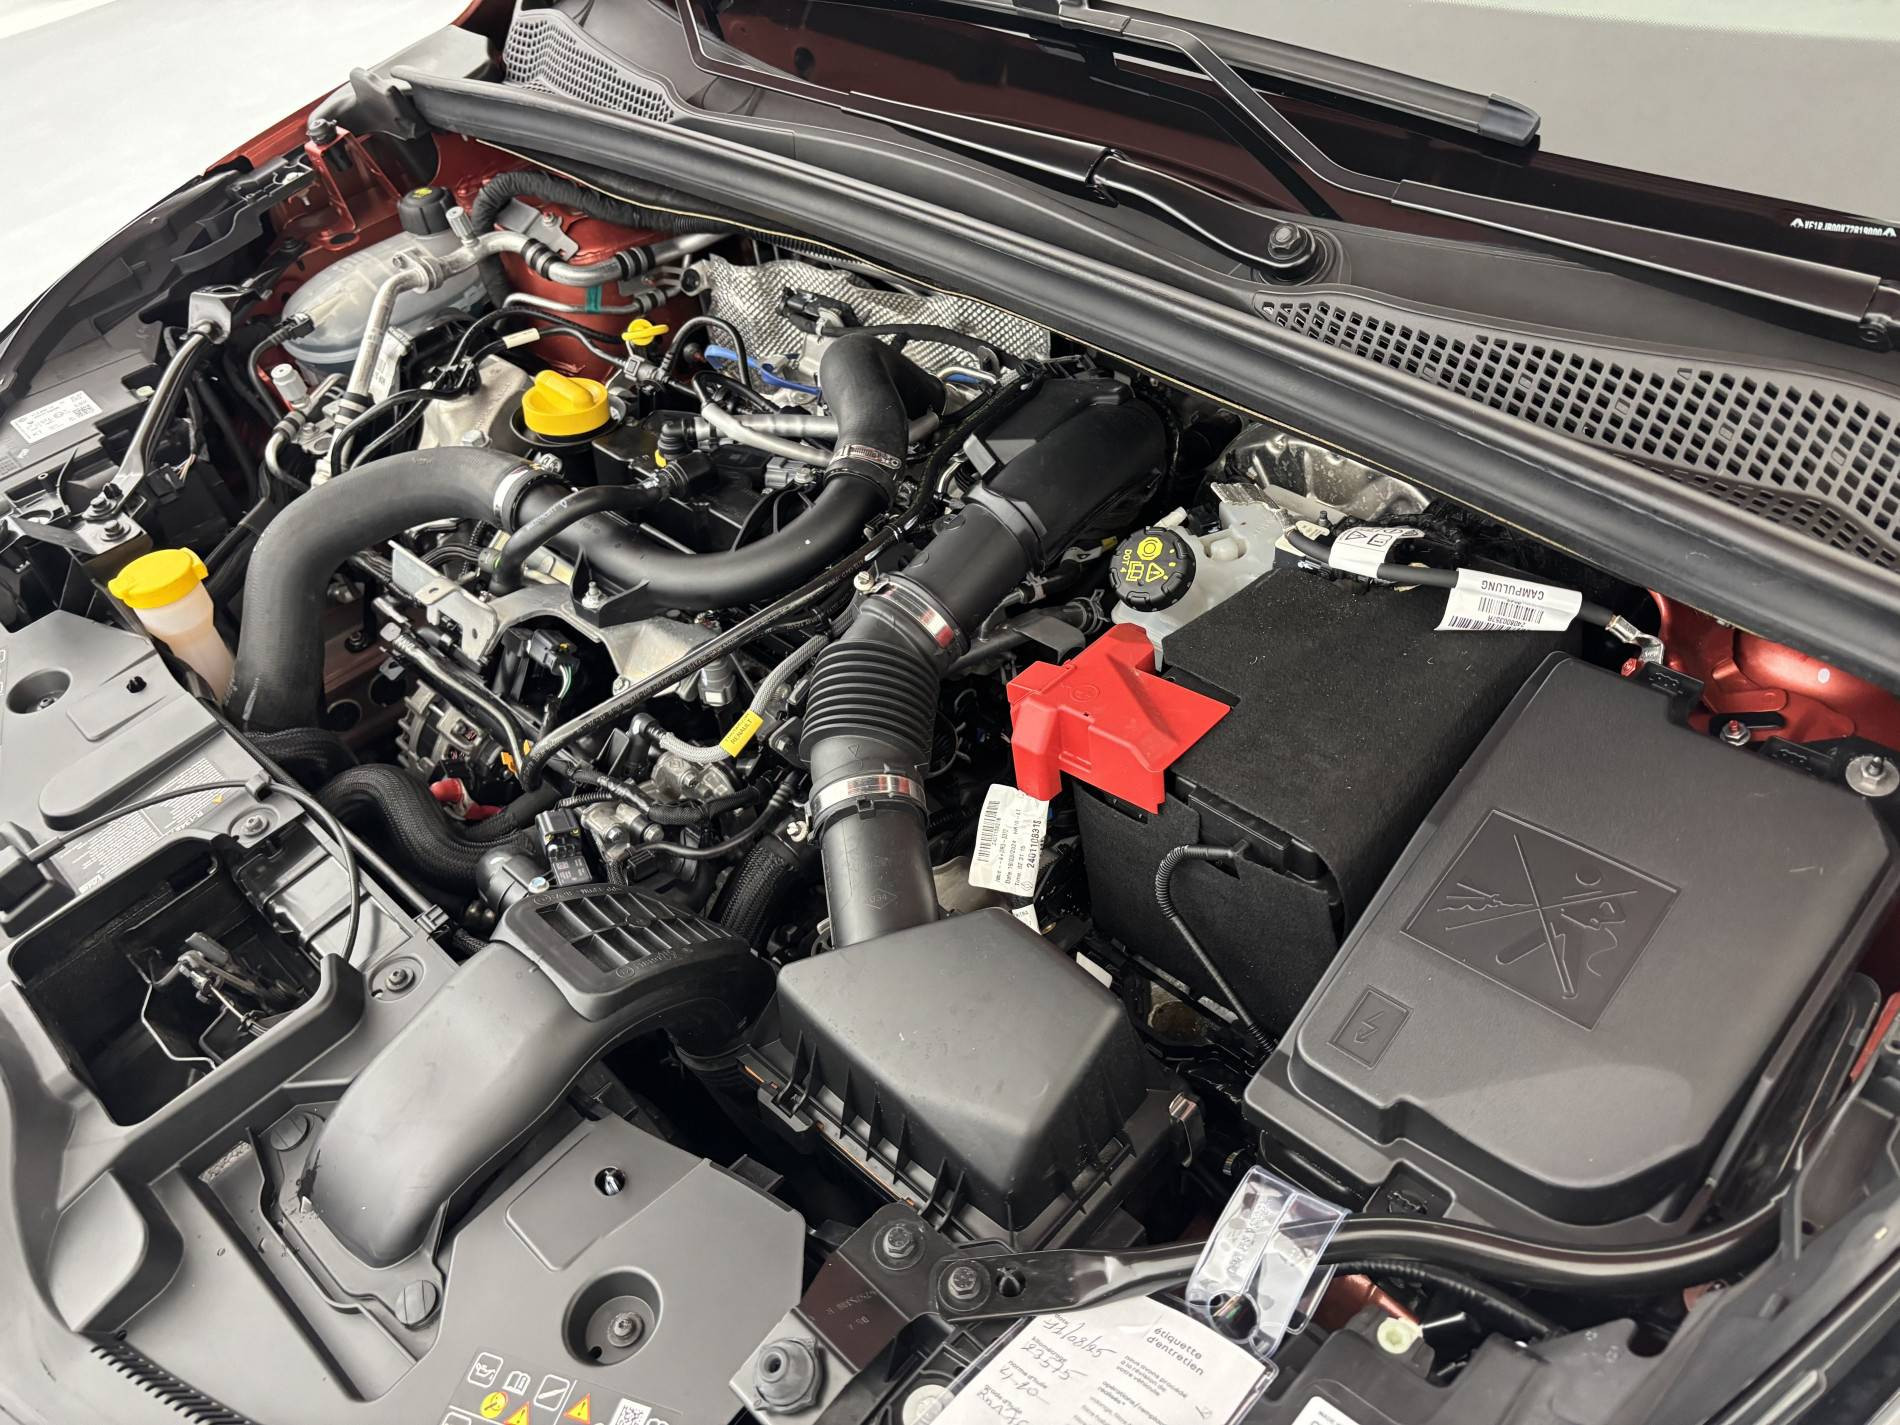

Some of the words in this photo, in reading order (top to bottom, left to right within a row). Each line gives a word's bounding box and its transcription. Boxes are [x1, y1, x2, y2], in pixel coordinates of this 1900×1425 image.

[1481, 580, 1545, 600] CAMPULUNG
[730, 719, 752, 744] RENAULT
[1146, 1336, 1205, 1376] d'entretien
[1154, 1327, 1203, 1360] étiquette
